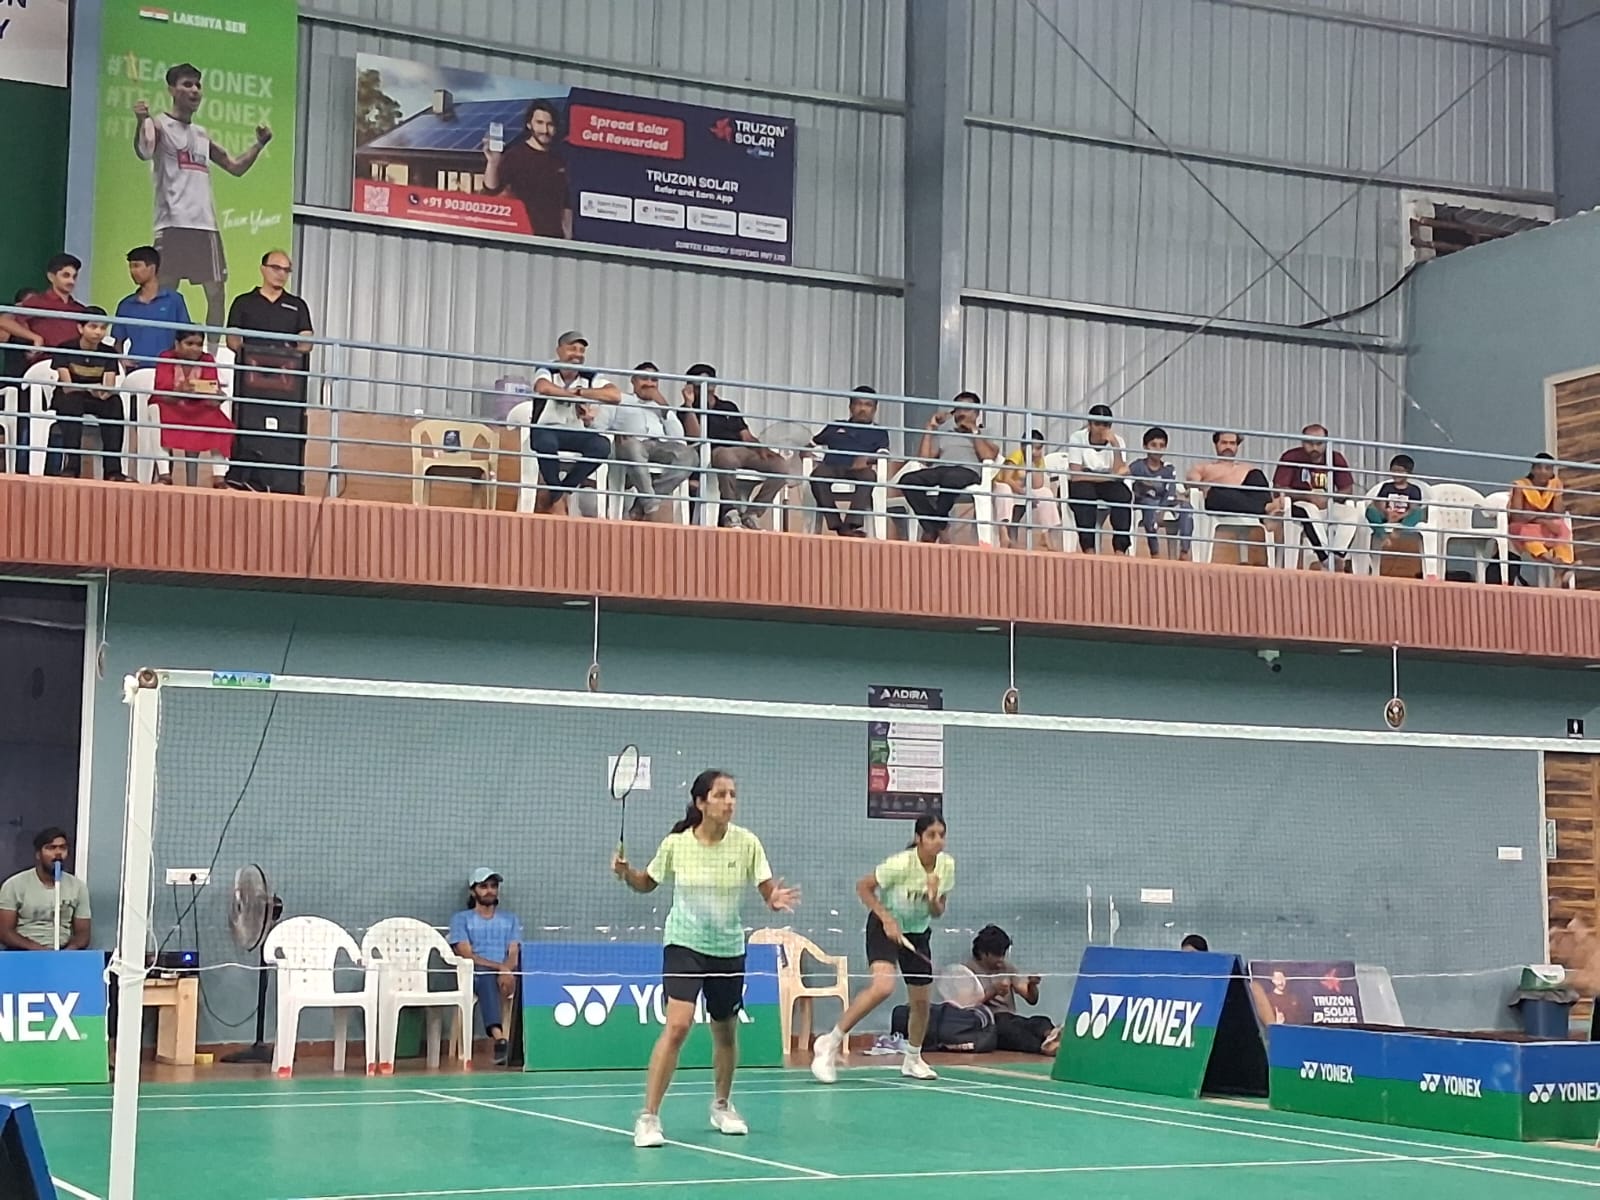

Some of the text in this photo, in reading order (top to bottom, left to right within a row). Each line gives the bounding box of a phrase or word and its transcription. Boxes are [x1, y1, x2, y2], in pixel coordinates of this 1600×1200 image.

[590, 114, 669, 136] Spread Solar
[735, 119, 785, 138] TRUZON
[582, 129, 669, 151] Get Rewarded
[735, 132, 775, 149] SOLAR
[646, 169, 739, 193] TRUZON SOLAR
[423, 196, 442, 209] +91
[716, 193, 734, 205] App
[892, 688, 929, 700] ADIRA
[1312, 995, 1355, 1007] TRUZON
[1323, 1006, 1357, 1017] SOLAR
[1121, 996, 1202, 1048] YONEX
[1320, 1062, 1354, 1084] YONEX
[1443, 1075, 1482, 1098] YONEX
